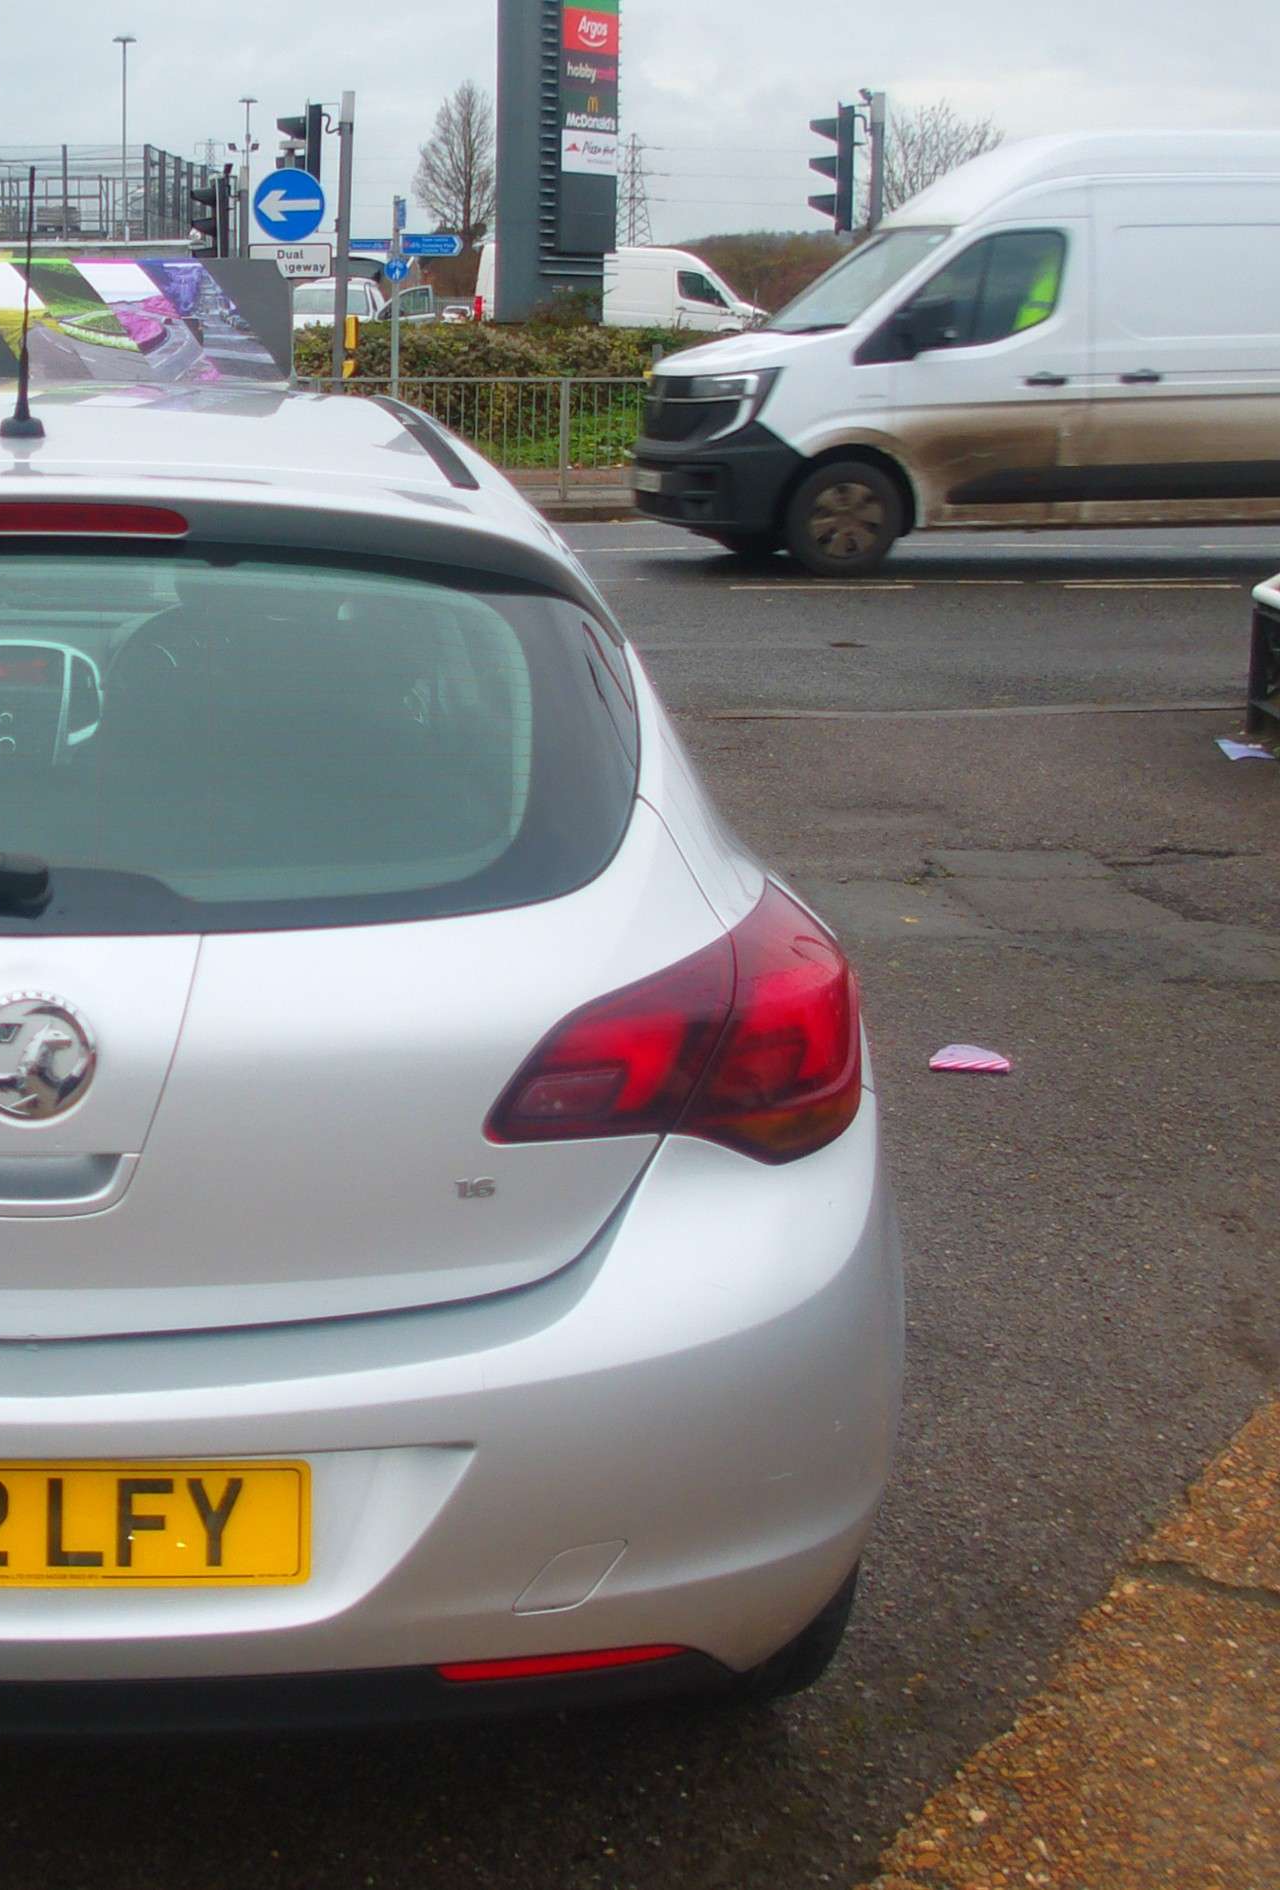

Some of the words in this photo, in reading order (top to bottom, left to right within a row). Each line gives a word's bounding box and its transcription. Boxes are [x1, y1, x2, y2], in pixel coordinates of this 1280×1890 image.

[578, 15, 608, 39] Argos
[277, 249, 304, 259] Dual
[45, 1477, 244, 1568] LFY
